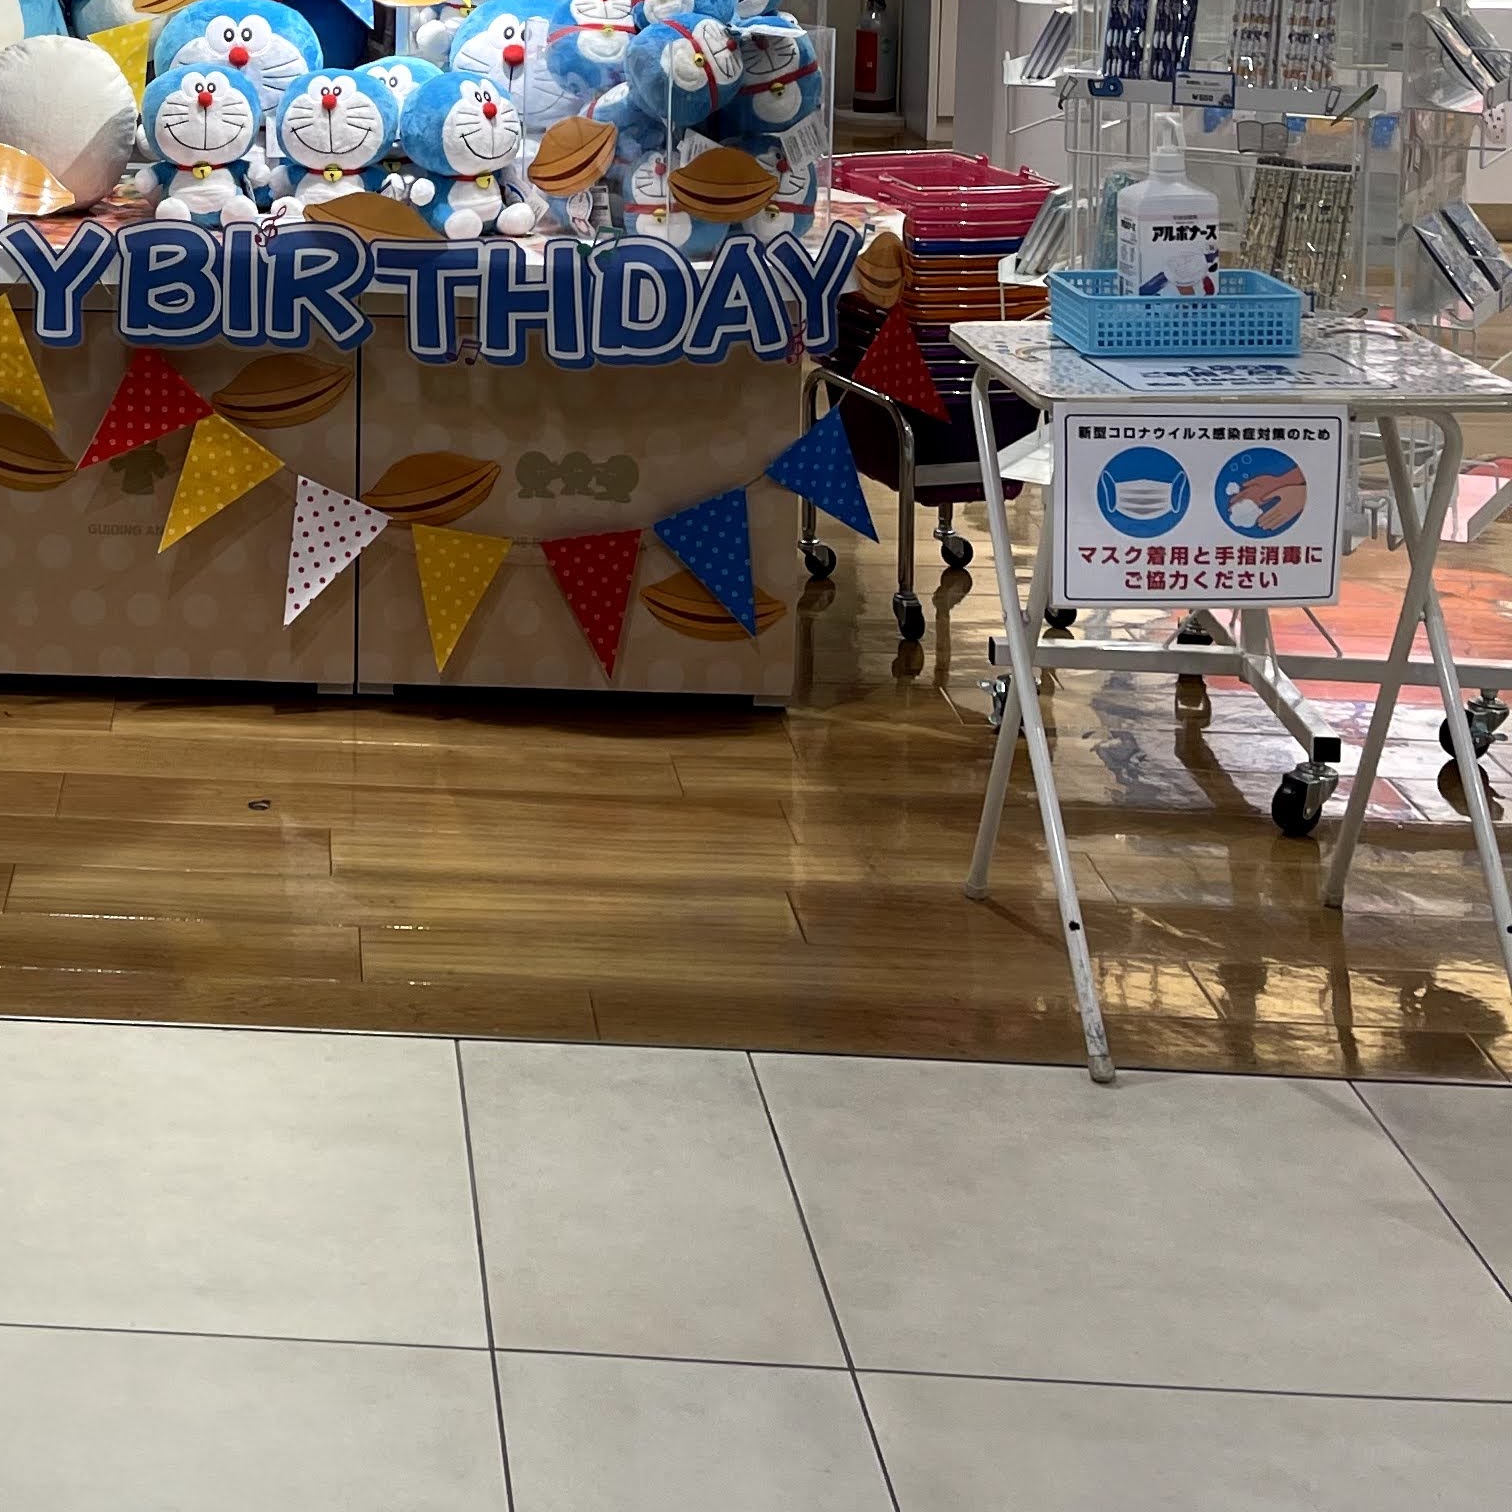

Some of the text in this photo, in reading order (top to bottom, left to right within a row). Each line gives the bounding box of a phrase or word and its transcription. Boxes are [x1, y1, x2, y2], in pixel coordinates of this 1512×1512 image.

[1152, 224, 1217, 242] アルボナース
[114, 219, 862, 367] BIRTHDAY
[1078, 426, 1331, 441] 新型コロナウイルス感染症対策のため
[1078, 546, 1324, 567] マスク着用と手指消毒に
[1125, 571, 1279, 590] ご協力ください
